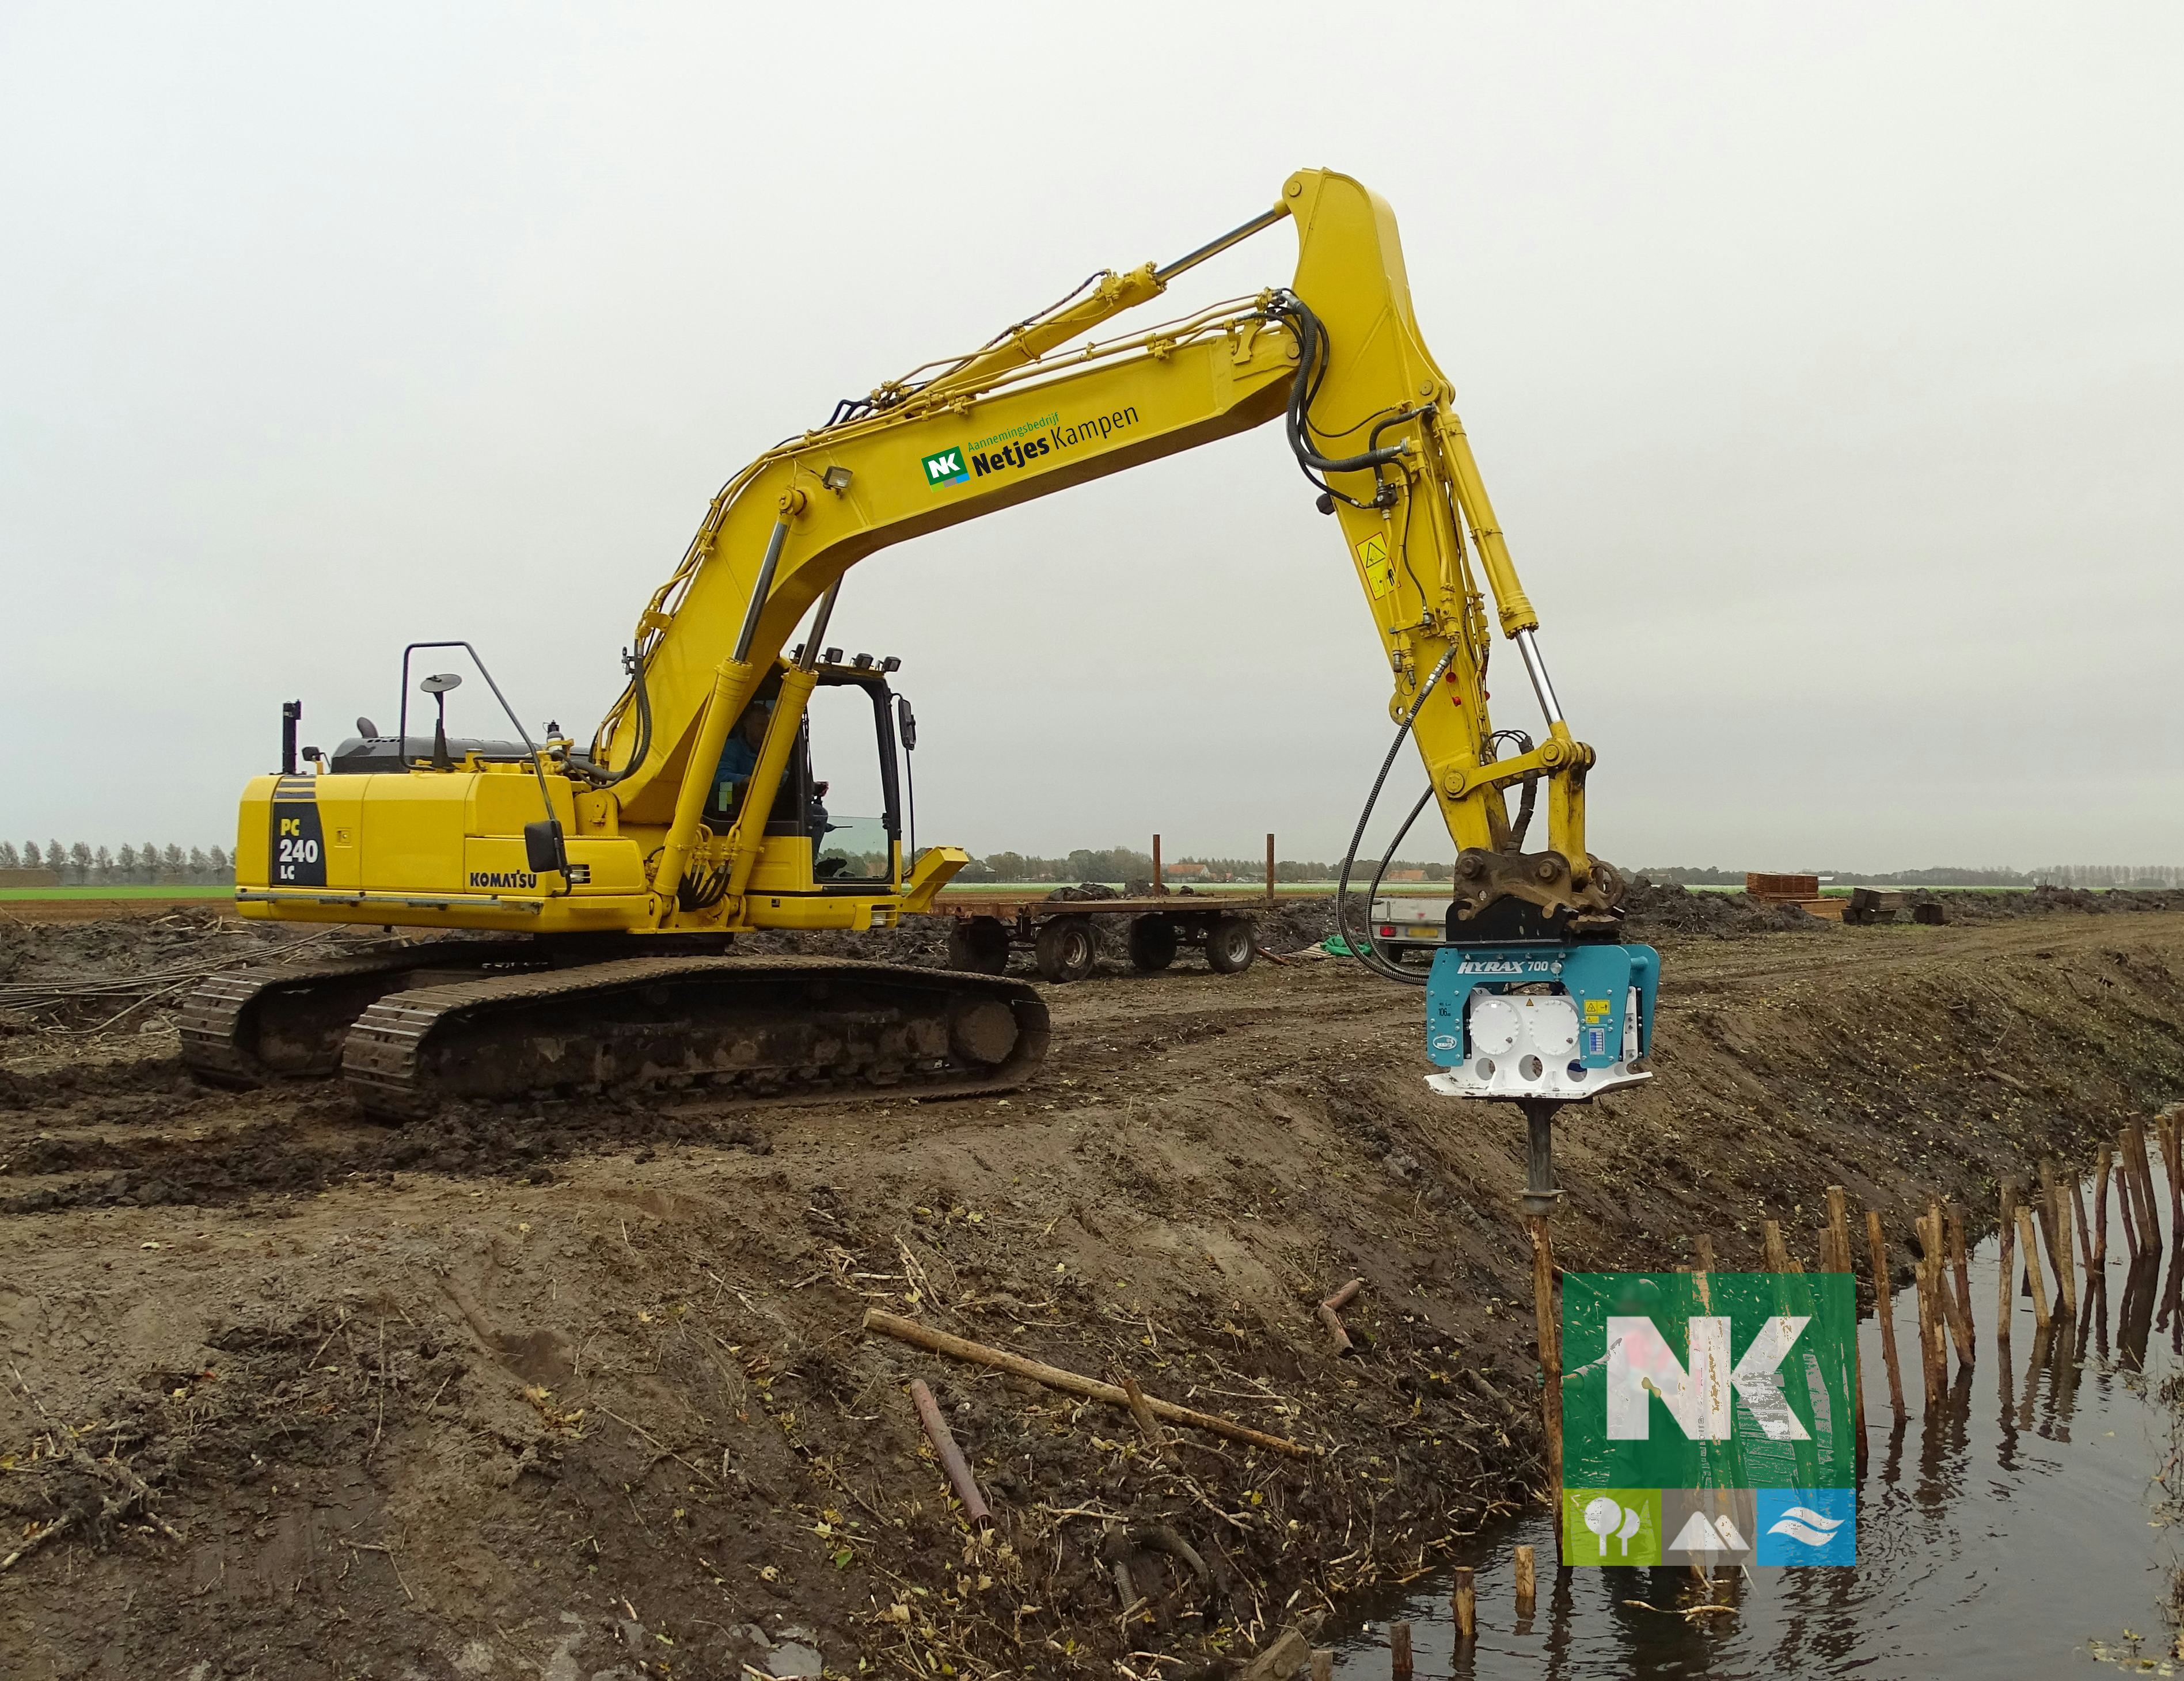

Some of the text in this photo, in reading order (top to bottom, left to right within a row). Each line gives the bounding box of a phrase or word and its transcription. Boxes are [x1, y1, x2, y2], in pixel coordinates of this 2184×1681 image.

[968, 412, 1059, 452] Aannemingsbedrijf
[971, 406, 1139, 477] Netjes Kampen
[928, 452, 960, 479] NK
[281, 819, 300, 836] PC
[279, 839, 318, 863] 240
[280, 865, 295, 880] LC
[470, 869, 537, 888] KOMATSU
[1457, 961, 1548, 974] HYRAX 700
